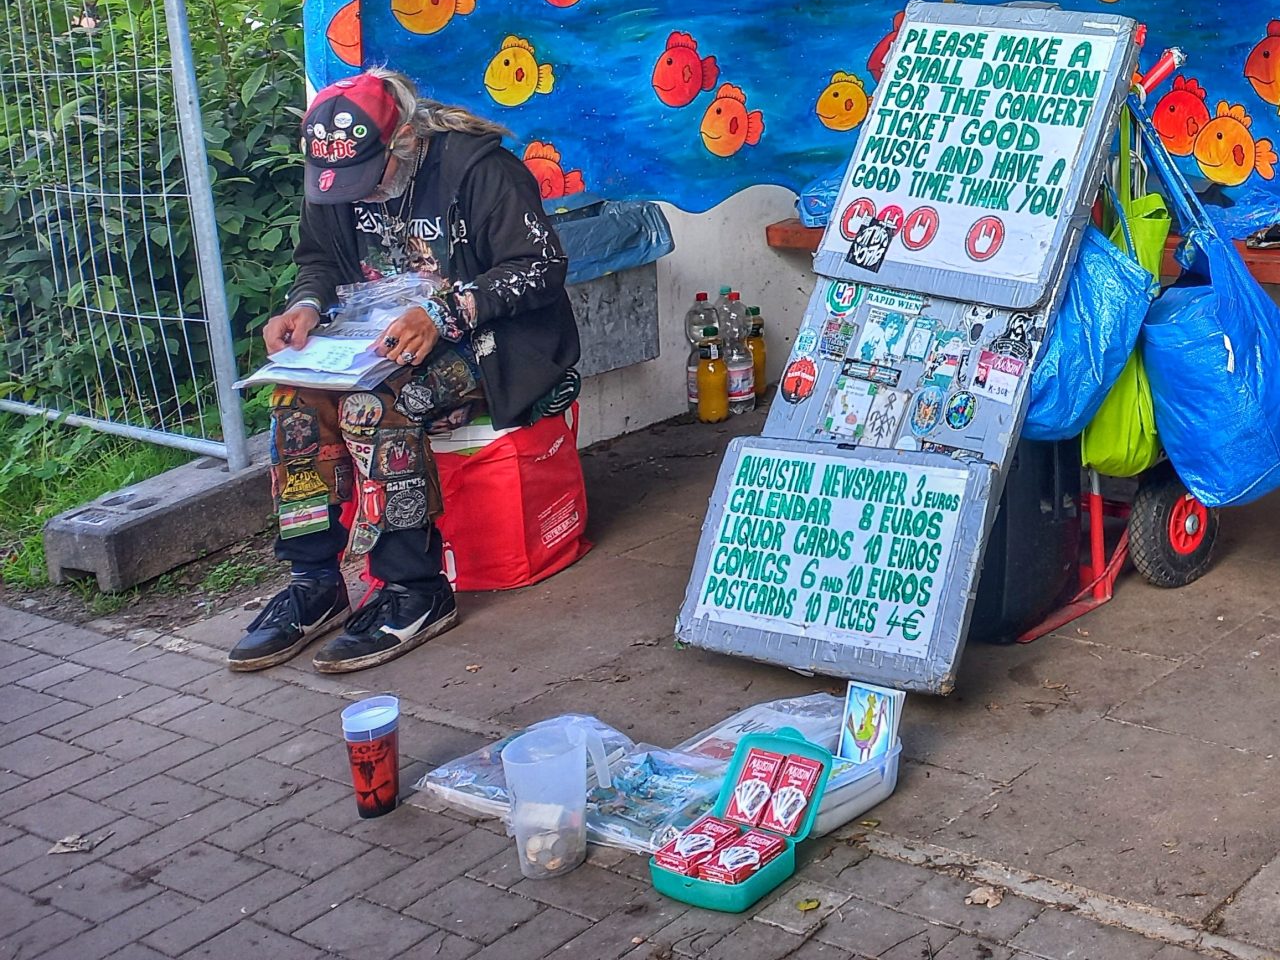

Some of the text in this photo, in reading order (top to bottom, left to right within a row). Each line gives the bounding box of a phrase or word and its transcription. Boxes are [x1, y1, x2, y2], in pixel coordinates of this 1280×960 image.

[901, 28, 1093, 67] PLEASE MAKE A
[893, 57, 1101, 98] SMALL DONATION
[882, 81, 1094, 128] FOR THE CONCERT
[874, 109, 1041, 151] TICKET GOOD
[861, 136, 1067, 183] MUSIC AND HAVE A
[852, 164, 901, 191] GOOD
[959, 175, 1019, 211] THANK
[868, 293, 896, 306] RAPID
[898, 300, 922, 311] WIEN
[735, 455, 961, 512] AUGUSTIN NEWSPAPER 3 EUROS
[729, 488, 944, 540] CALENDAR 8 EUROS
[719, 514, 943, 574] LIQUOR CARDS 10 EUROS
[713, 545, 934, 607] COMICS 6 AND 10 EUROS
[702, 575, 926, 641] POSTCARDS 10 PIECES 4€
